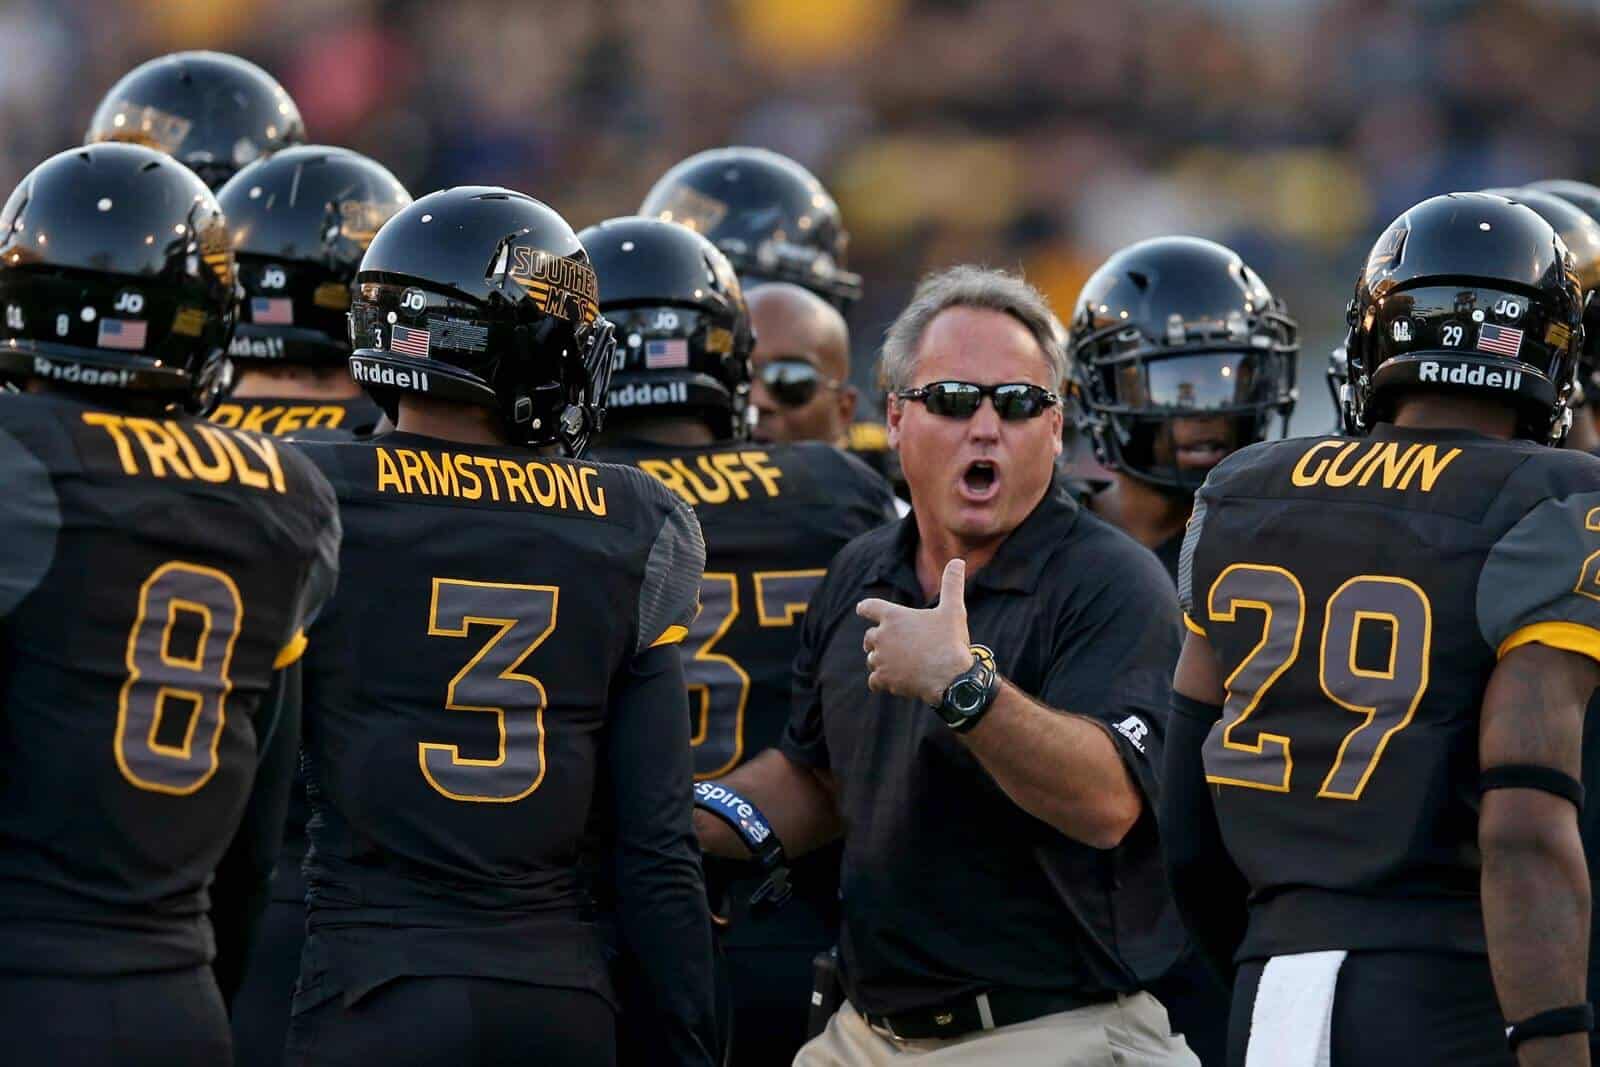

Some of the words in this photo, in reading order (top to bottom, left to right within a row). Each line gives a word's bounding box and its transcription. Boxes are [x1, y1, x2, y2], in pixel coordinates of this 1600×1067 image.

[261, 268, 286, 289] JO
[114, 292, 144, 314] JO
[401, 292, 425, 310] JO
[1495, 298, 1521, 318] JO
[653, 311, 679, 330] JO
[373, 328, 383, 349] 3
[1442, 325, 1464, 348] 29
[351, 360, 429, 392] Riddell
[1418, 360, 1523, 391] Riddell
[608, 380, 688, 409] iddell
[81, 411, 287, 495] TRULY
[1291, 438, 1463, 493] GUNN
[376, 446, 608, 517] ARMSTRONG
[114, 561, 245, 797] 8
[418, 577, 560, 804] 3
[1201, 562, 1433, 801] 29
[693, 783, 754, 819] spire
